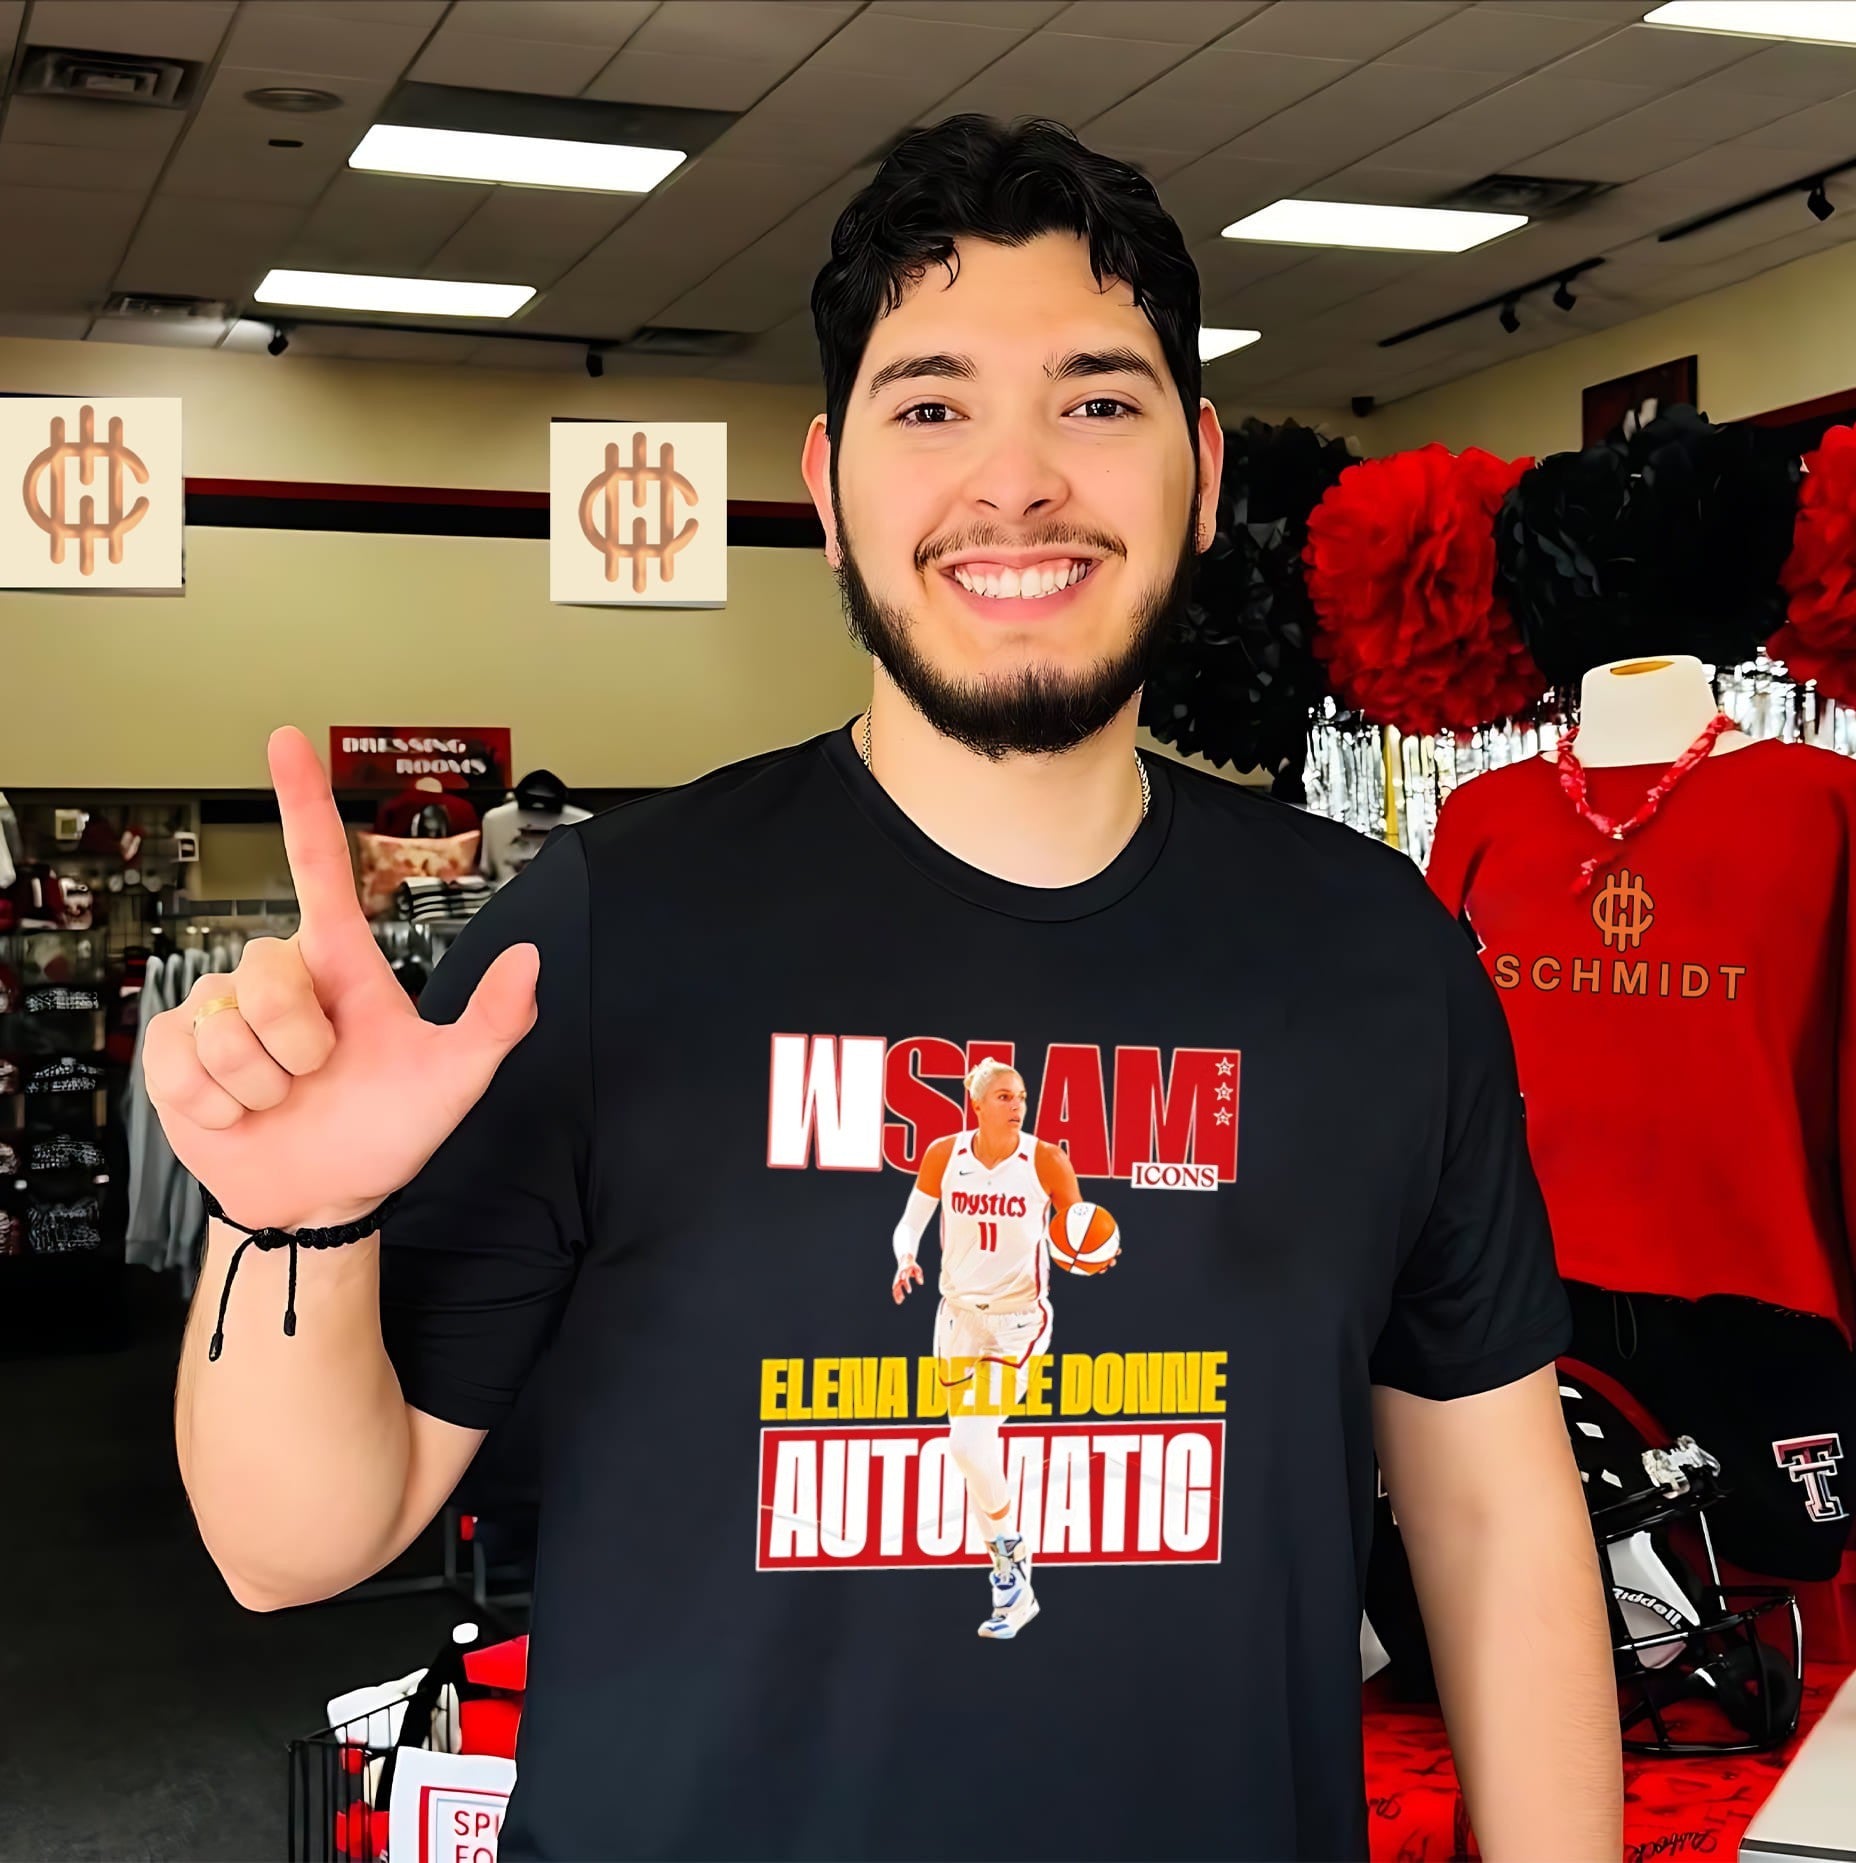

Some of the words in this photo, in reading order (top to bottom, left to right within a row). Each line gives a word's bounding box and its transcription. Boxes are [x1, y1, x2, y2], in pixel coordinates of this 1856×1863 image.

[396, 758, 487, 775] ROOMS
[1494, 953, 1747, 1000] SCHMIDT
[1134, 1166, 1216, 1188] ICONS
[978, 1221, 998, 1253] 11
[760, 1356, 909, 1420] ELENA
[916, 1354, 1054, 1418] DELLE
[1060, 1351, 1228, 1415] DONNE
[768, 1432, 1213, 1558] AUTOMATIC
